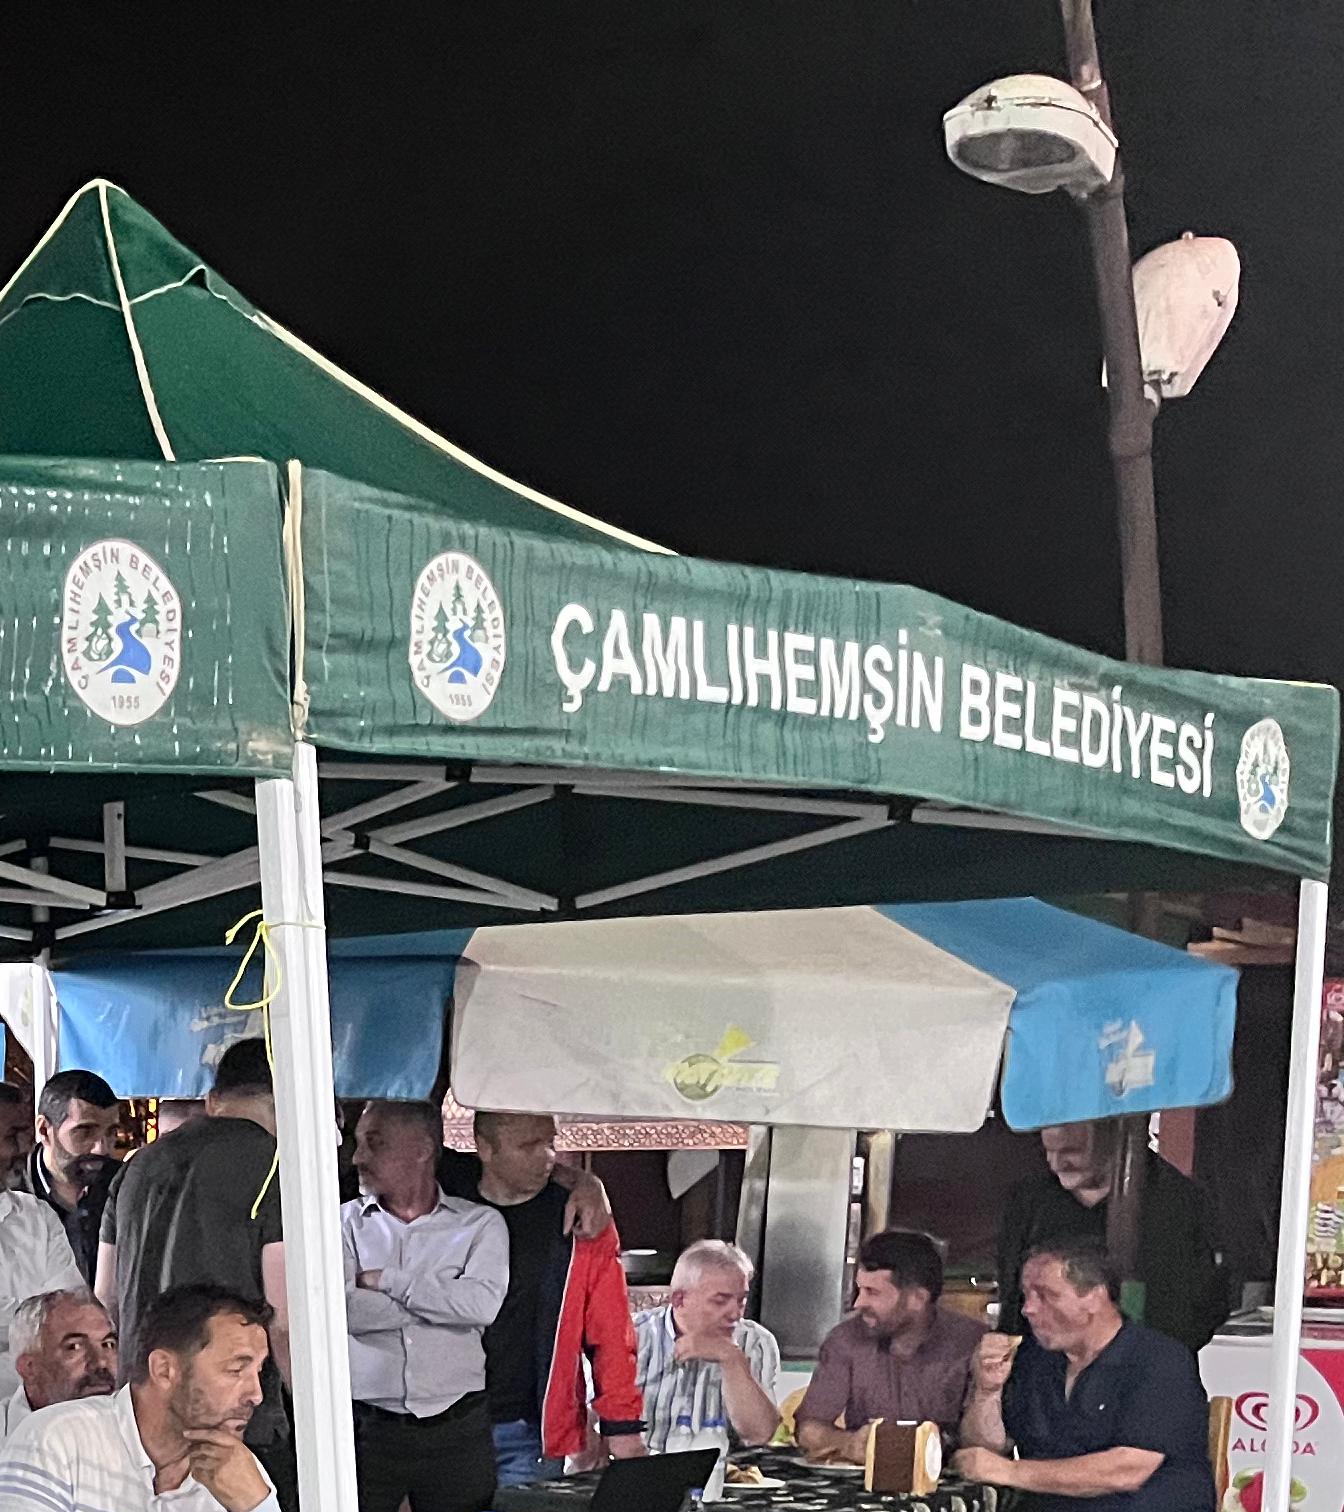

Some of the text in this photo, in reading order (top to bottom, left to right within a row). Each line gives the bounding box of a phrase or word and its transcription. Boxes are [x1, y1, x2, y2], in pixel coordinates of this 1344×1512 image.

[551, 604, 944, 744] ÇAMLIHEMŞİN
[960, 663, 1214, 798] BELEDİYESİ
[1232, 1438, 1316, 1456] ALDA
